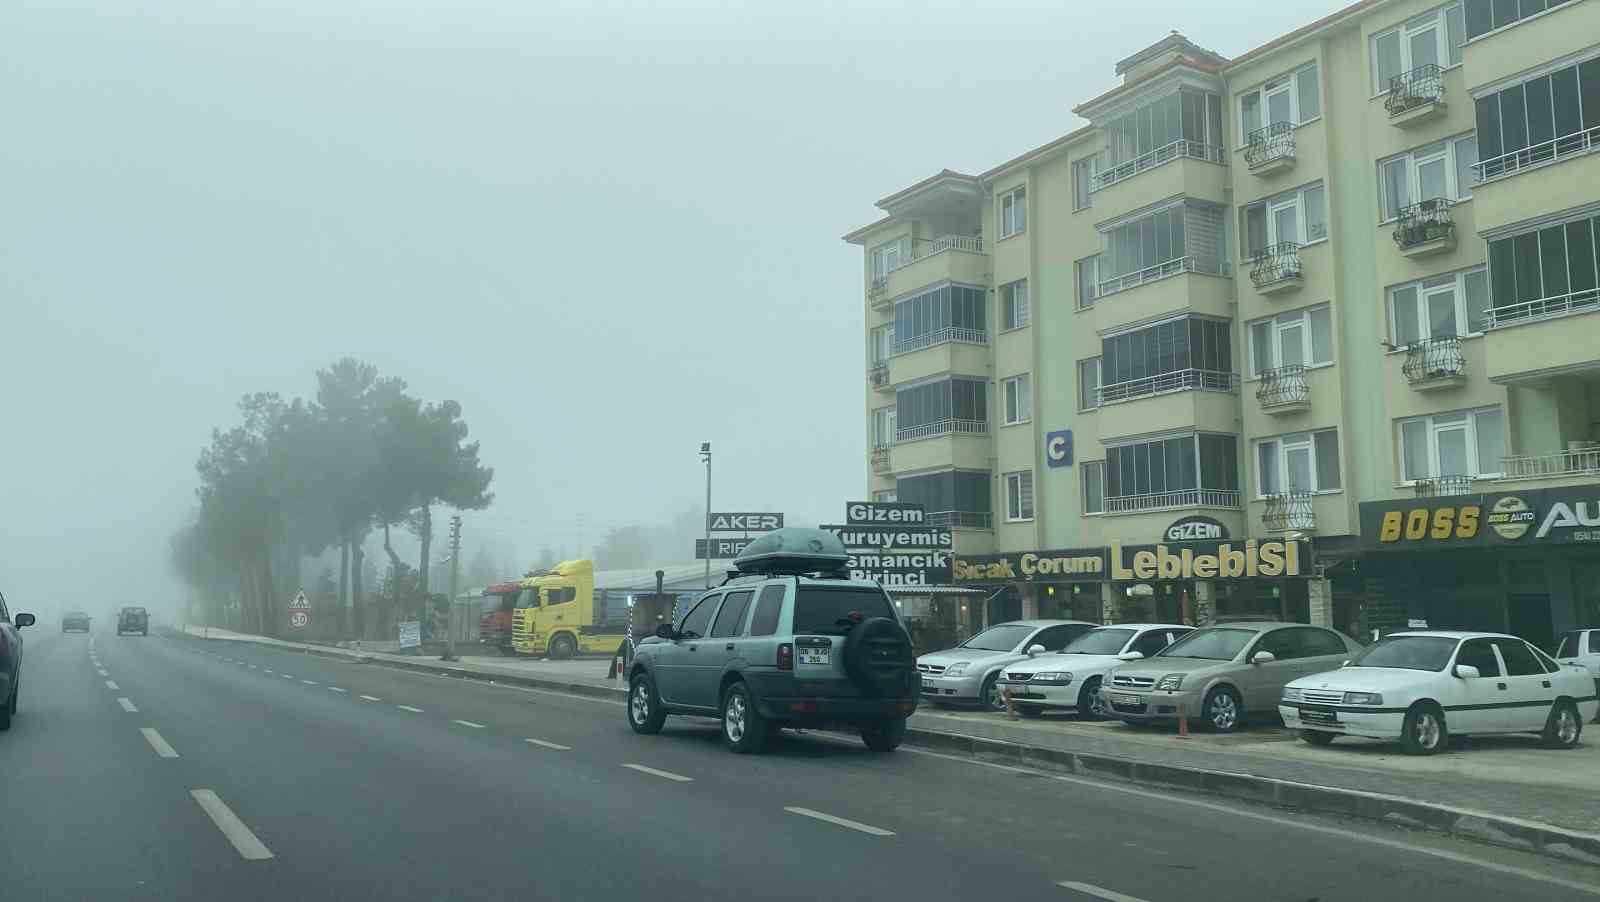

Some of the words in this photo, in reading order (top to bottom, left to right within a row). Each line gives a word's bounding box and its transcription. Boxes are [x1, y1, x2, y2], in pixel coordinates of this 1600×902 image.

[1049, 436, 1065, 460] C
[849, 504, 923, 522] Gizem
[1510, 512, 1535, 523] AUTO
[711, 515, 779, 529] AKER
[1380, 505, 1480, 543] BOSS
[720, 542, 746, 554] RIF
[845, 551, 947, 568] smancık
[1020, 553, 1103, 581] Çorum
